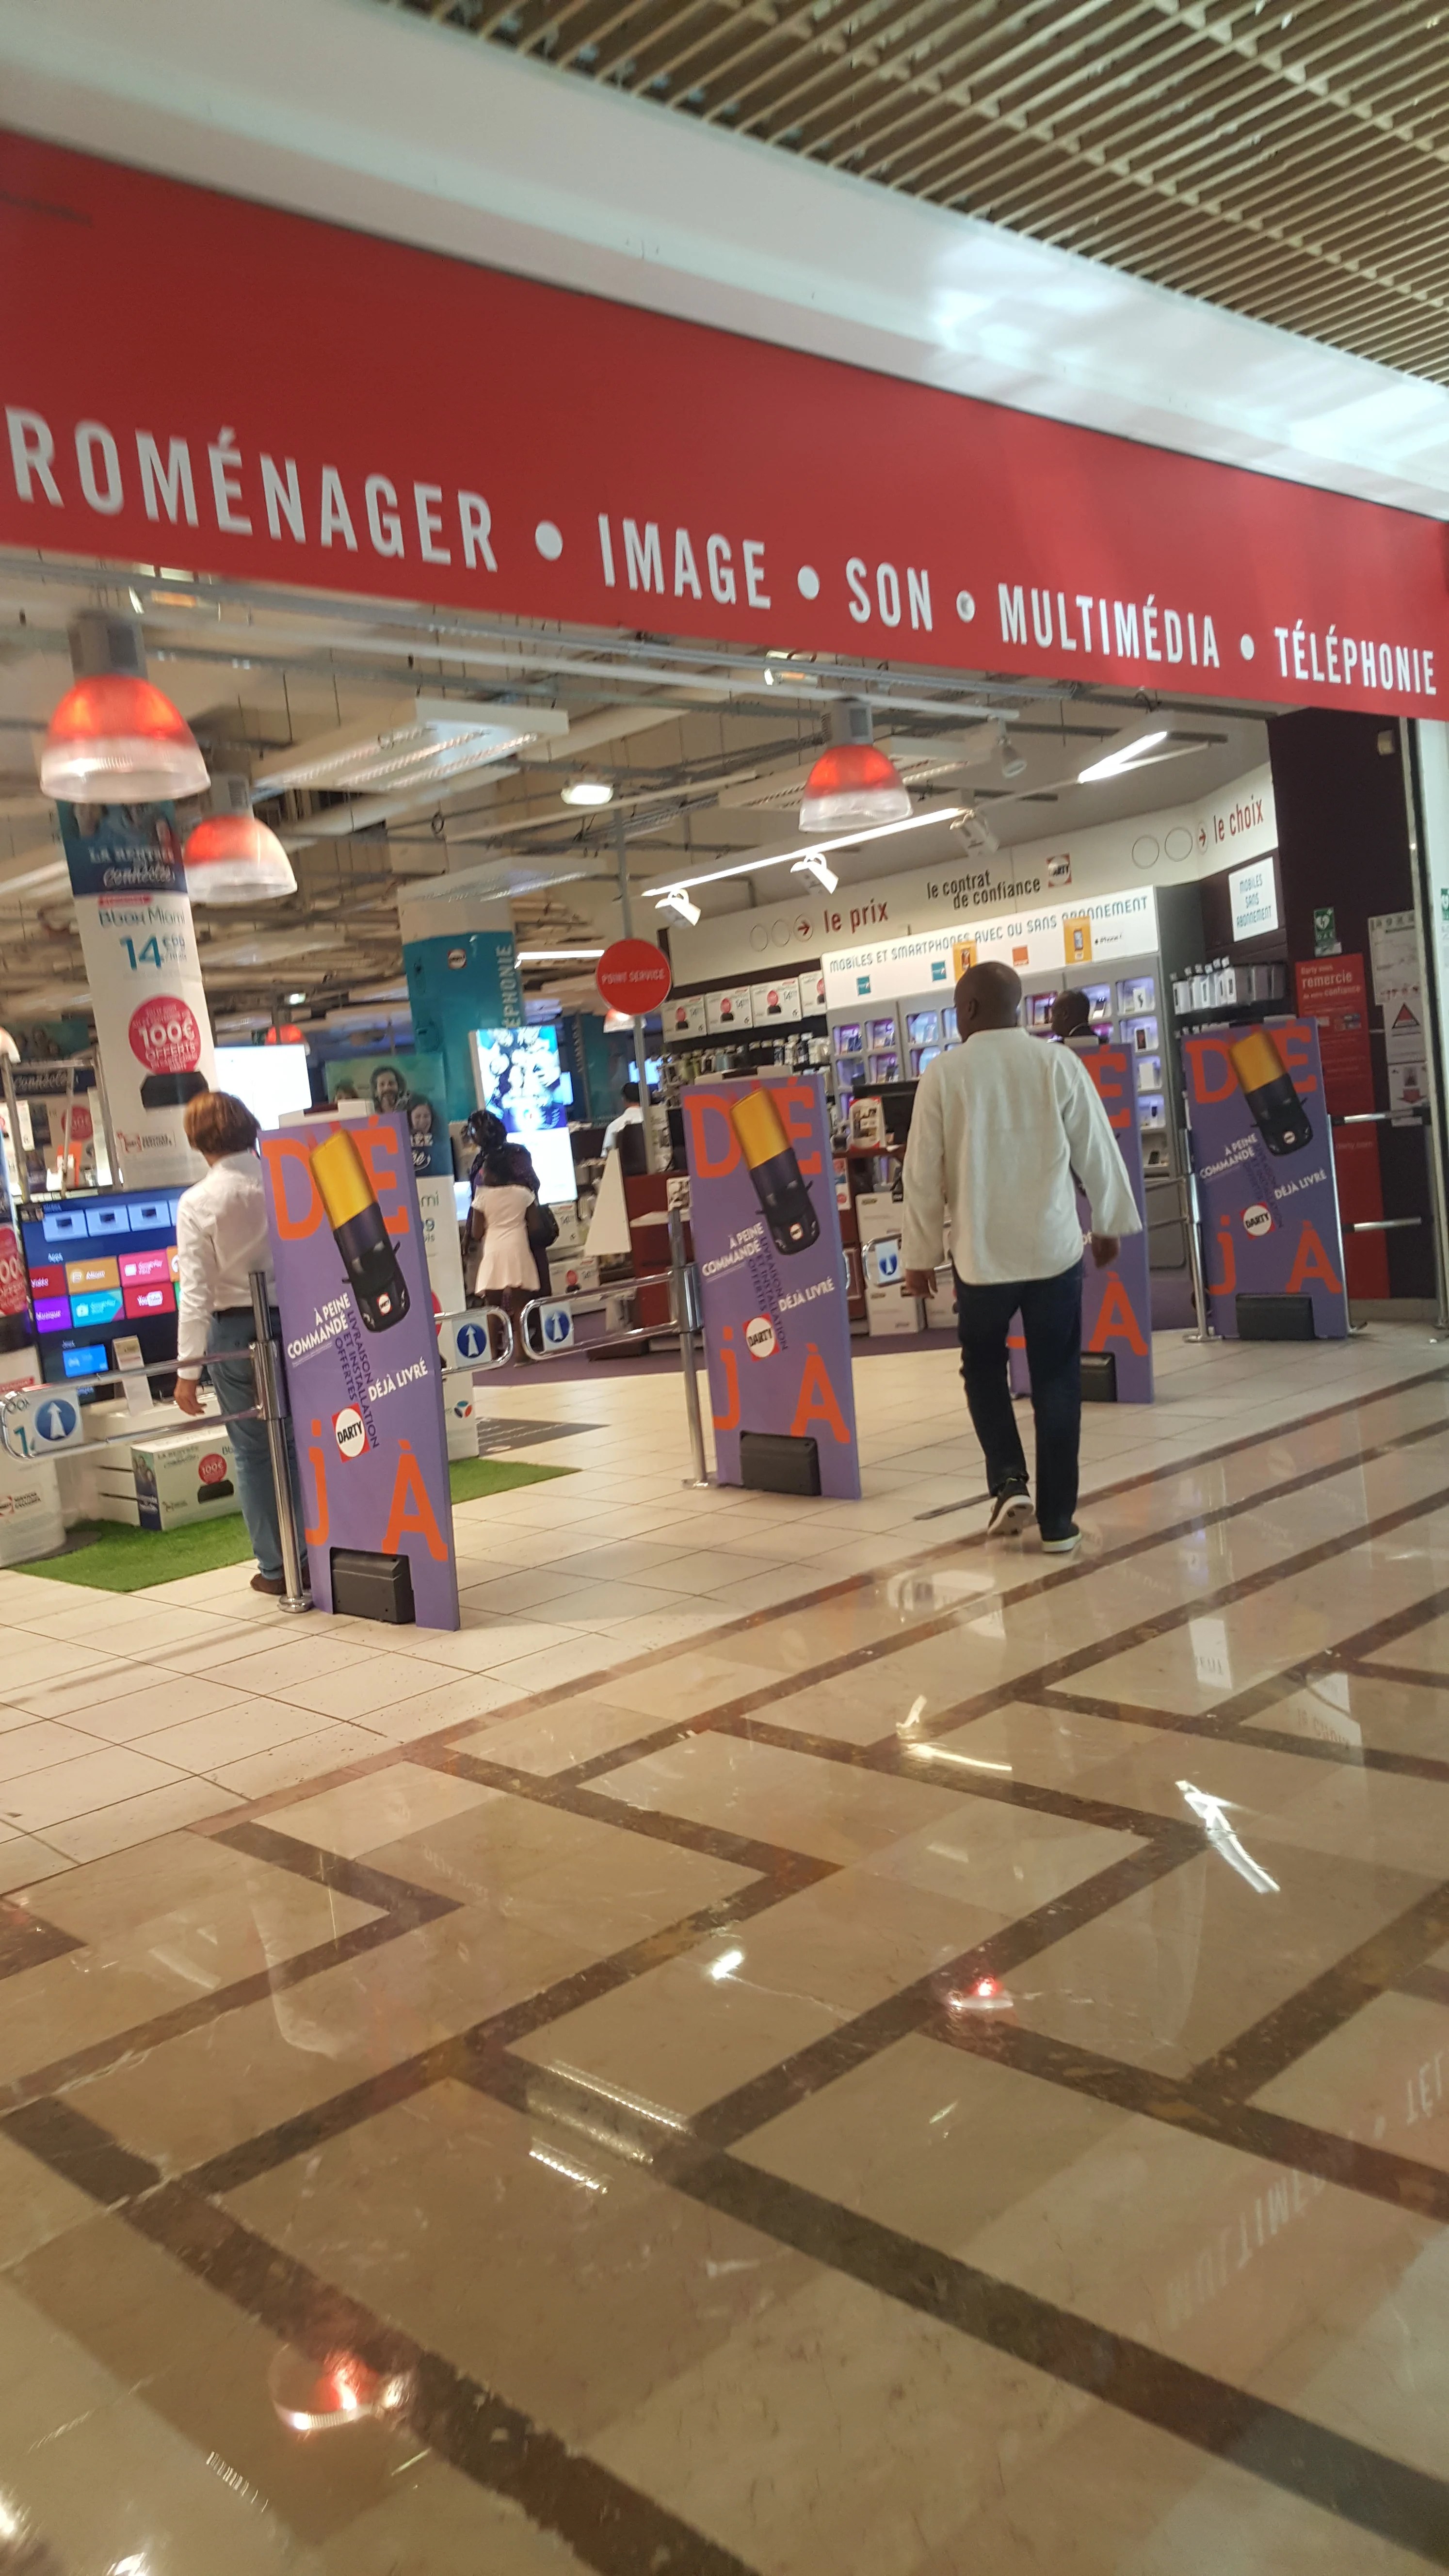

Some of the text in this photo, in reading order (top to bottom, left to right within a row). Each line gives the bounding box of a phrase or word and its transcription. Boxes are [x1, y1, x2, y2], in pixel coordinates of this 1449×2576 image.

[5, 404, 1437, 696] ROMÉNAGER IMAGE SON MULTIMÉDIA TÉLÉPHONIE
[1213, 794, 1264, 844] le choix
[927, 869, 991, 900] le contrat
[953, 878, 1041, 910] de confiance
[1240, 874, 1263, 893] MOBILES
[823, 898, 889, 934] le prix
[830, 952, 873, 973] MOBILES
[876, 950, 887, 964] ET
[975, 926, 1004, 944] AVEC
[1007, 922, 1022, 937] OU
[1027, 915, 1058, 932] SANS
[1303, 970, 1352, 989] remercie
[139, 1019, 195, 1049] 100€
[1231, 1132, 1258, 1151] PEINE
[1199, 1145, 1255, 1179] COMMANDÉ
[1274, 1168, 1327, 1200] DÉJÀ LIVRÉ
[728, 1221, 765, 1250] À PEINE
[1245, 1212, 1270, 1229] DARTY
[702, 1237, 762, 1276] COMMANDÉ
[314, 1291, 351, 1326] À PEINE
[778, 1276, 836, 1312] DÉJÀ LIVRÉ
[287, 1310, 349, 1359] COMMANDÉ
[347, 1310, 374, 1385] LIVRAISON
[747, 1328, 773, 1347] DARTY
[336, 1337, 357, 1401] OFFERTES
[368, 1356, 428, 1402] DÉJÀ LIVRÉ
[338, 1421, 364, 1444] DARTY
